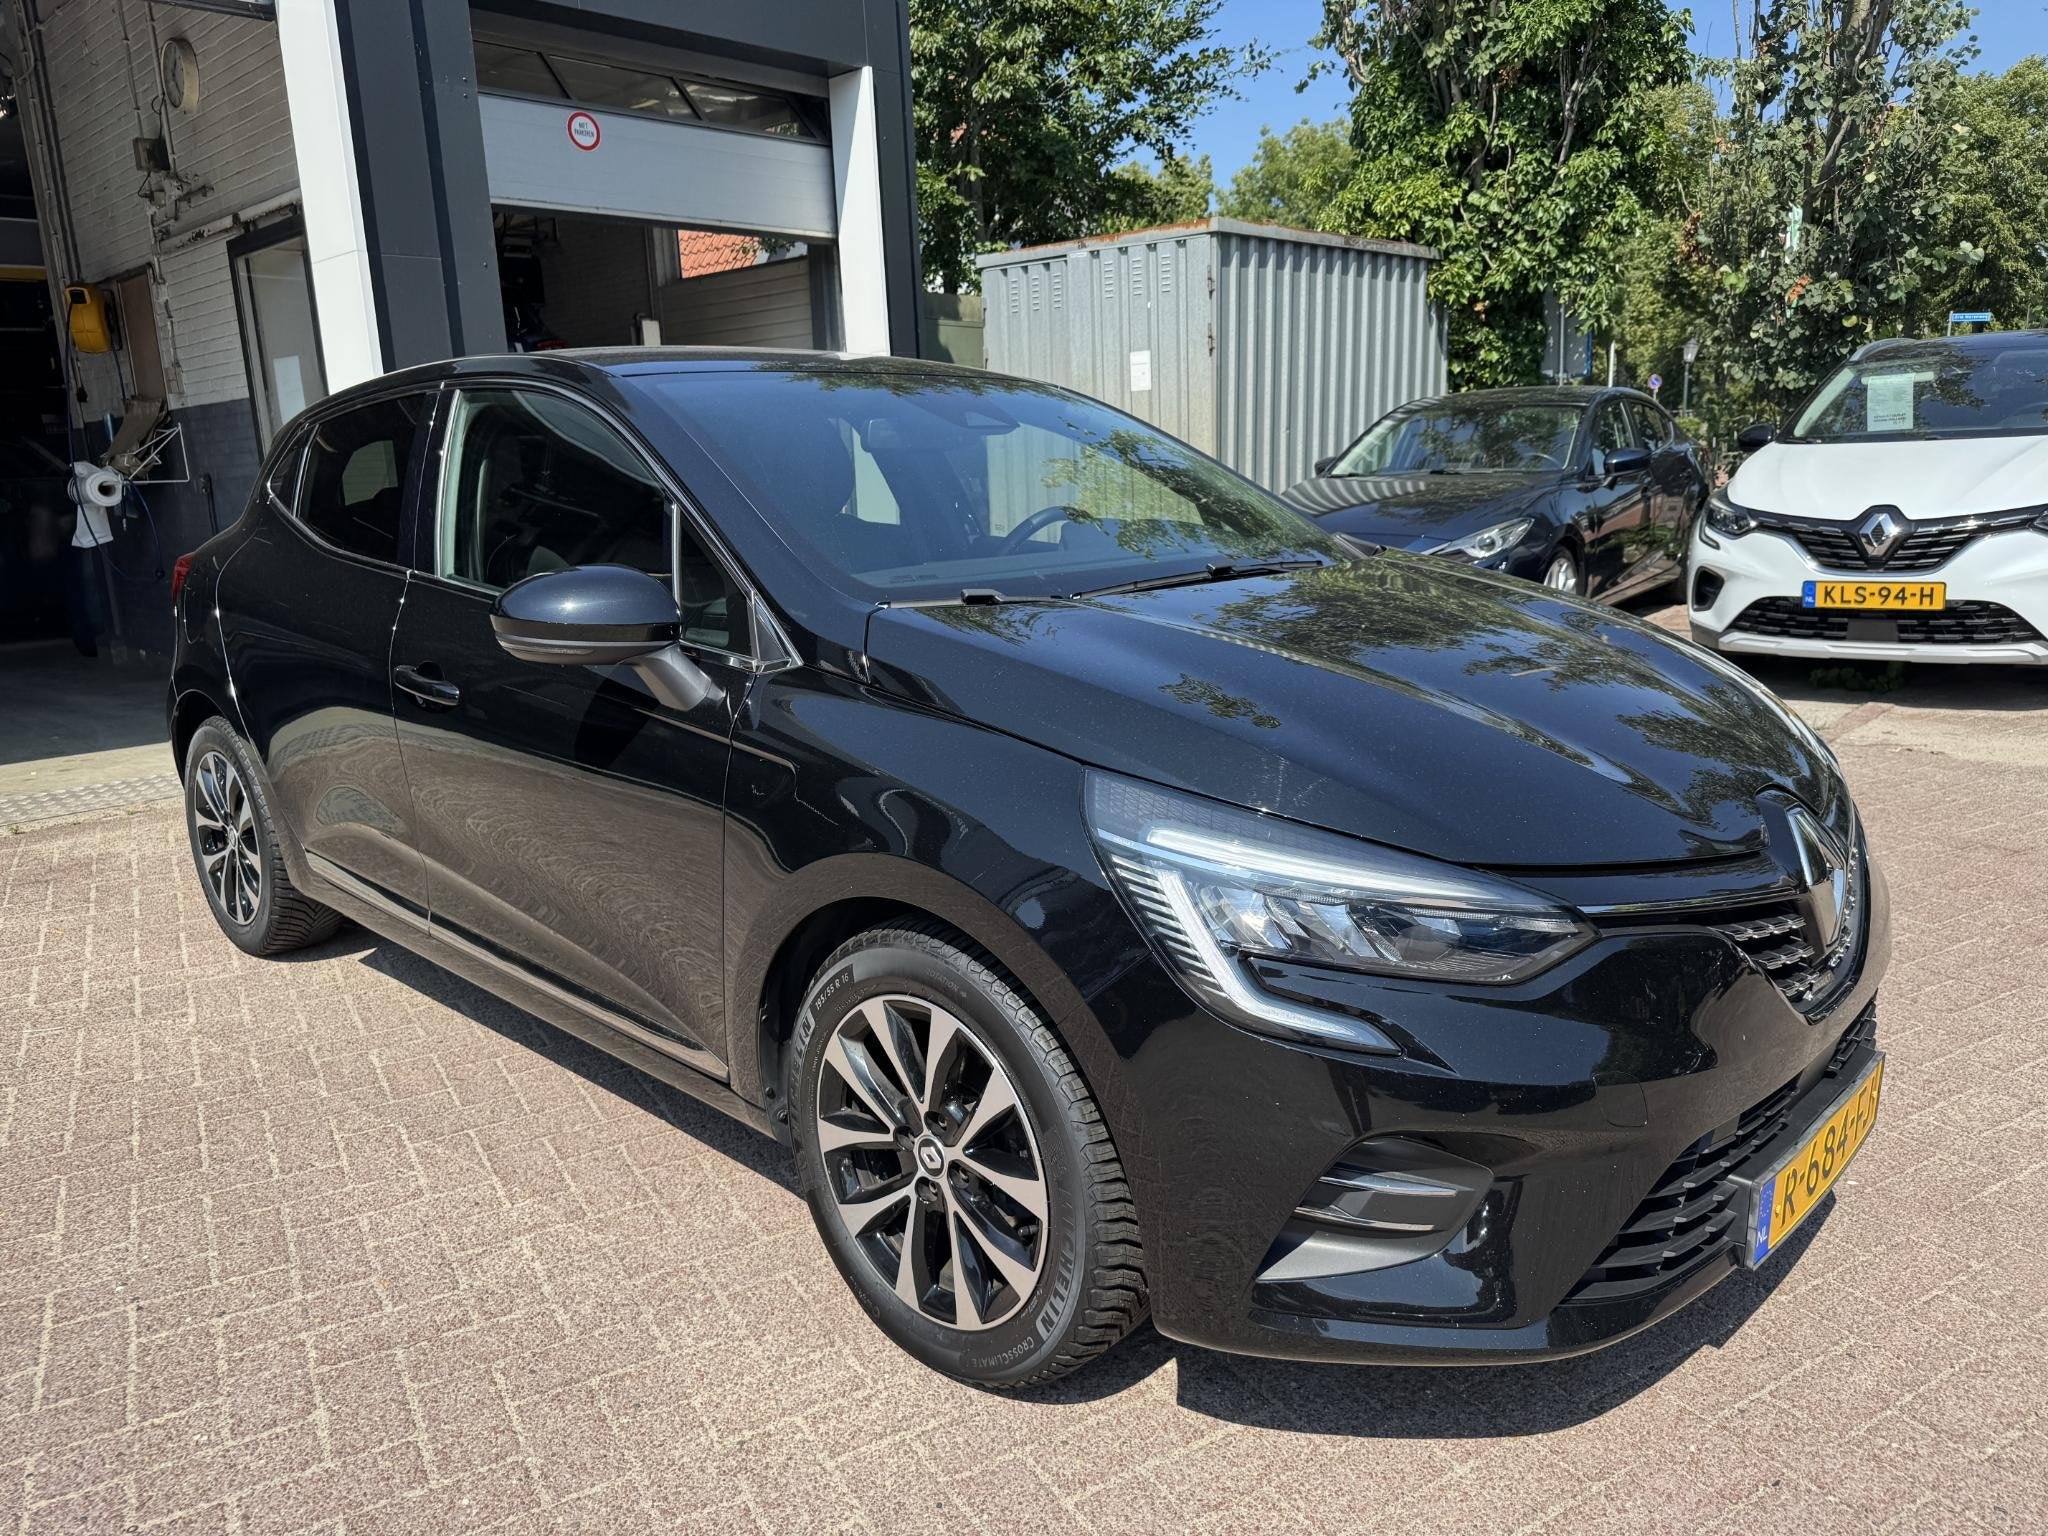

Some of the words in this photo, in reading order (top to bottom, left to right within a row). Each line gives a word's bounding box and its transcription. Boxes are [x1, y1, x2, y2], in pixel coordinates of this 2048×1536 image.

[1823, 585, 1935, 606] KLS-94-H
[815, 984, 835, 1010] 195/55
[1781, 1074, 1876, 1229] R-684-FJ
[1756, 1229, 1768, 1247] NL
